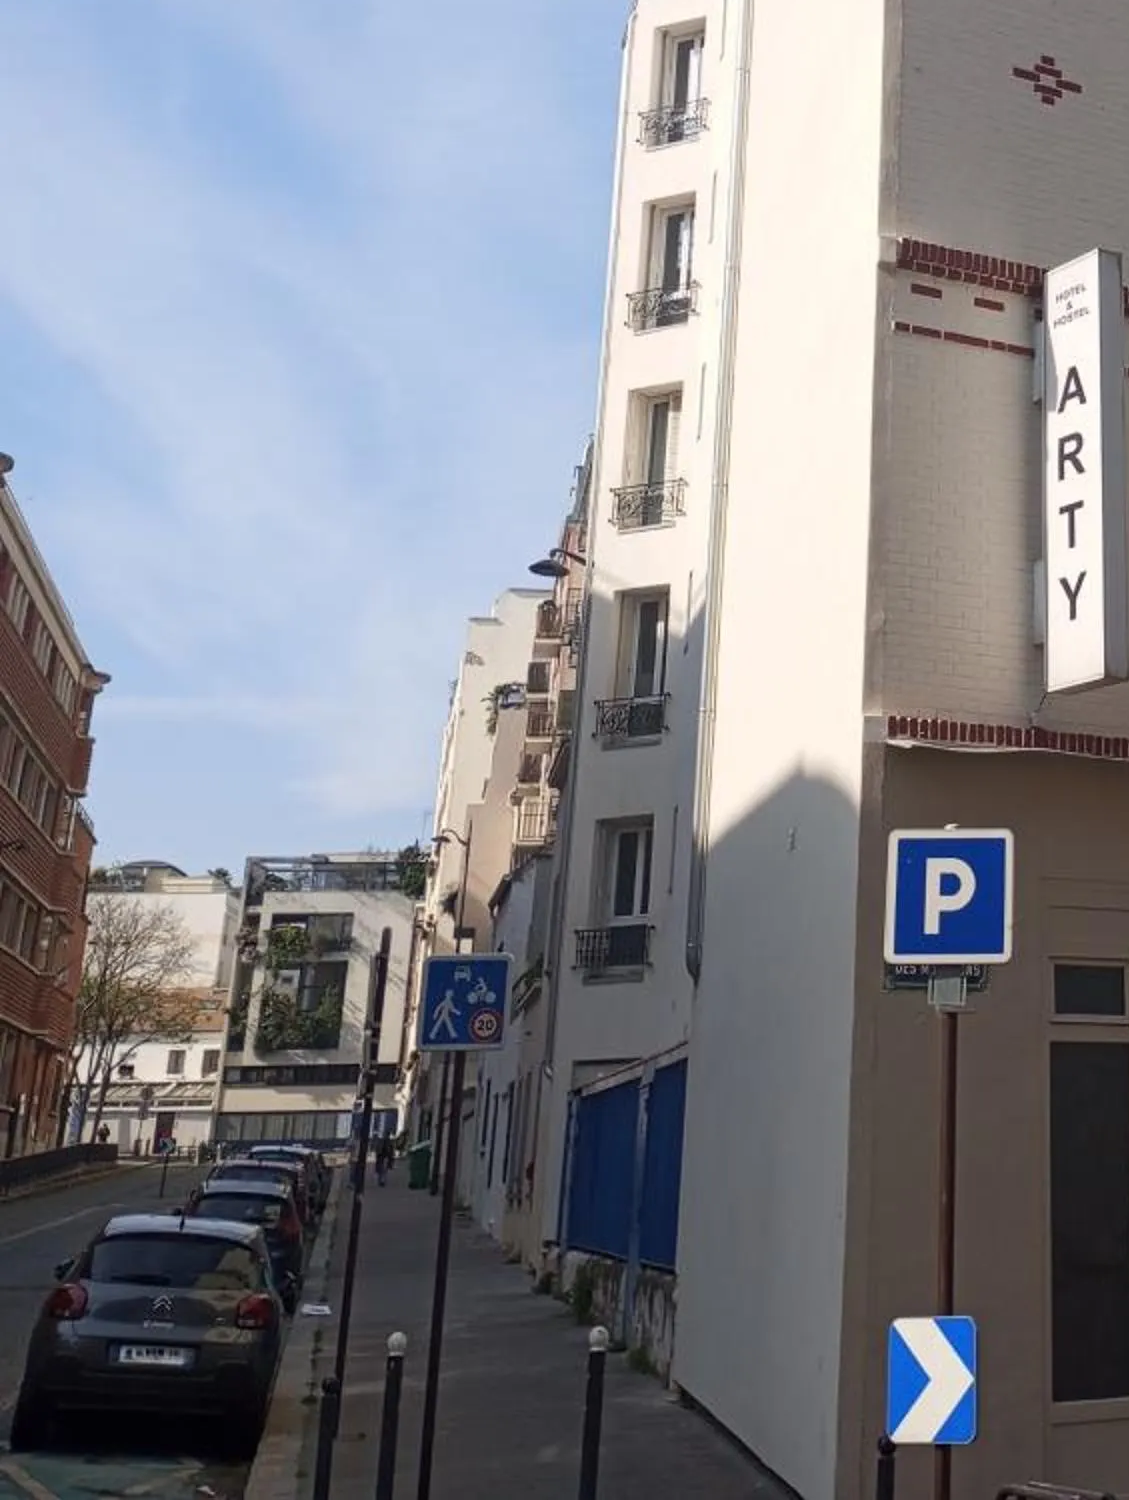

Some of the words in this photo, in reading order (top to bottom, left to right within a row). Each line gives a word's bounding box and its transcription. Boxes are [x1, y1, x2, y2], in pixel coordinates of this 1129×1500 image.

[1055, 284, 1086, 304] HOTEL
[1053, 307, 1090, 329] HOSTEL
[1057, 365, 1087, 621] ARTY
[923, 857, 977, 935] P
[477, 1019, 495, 1032] 20
